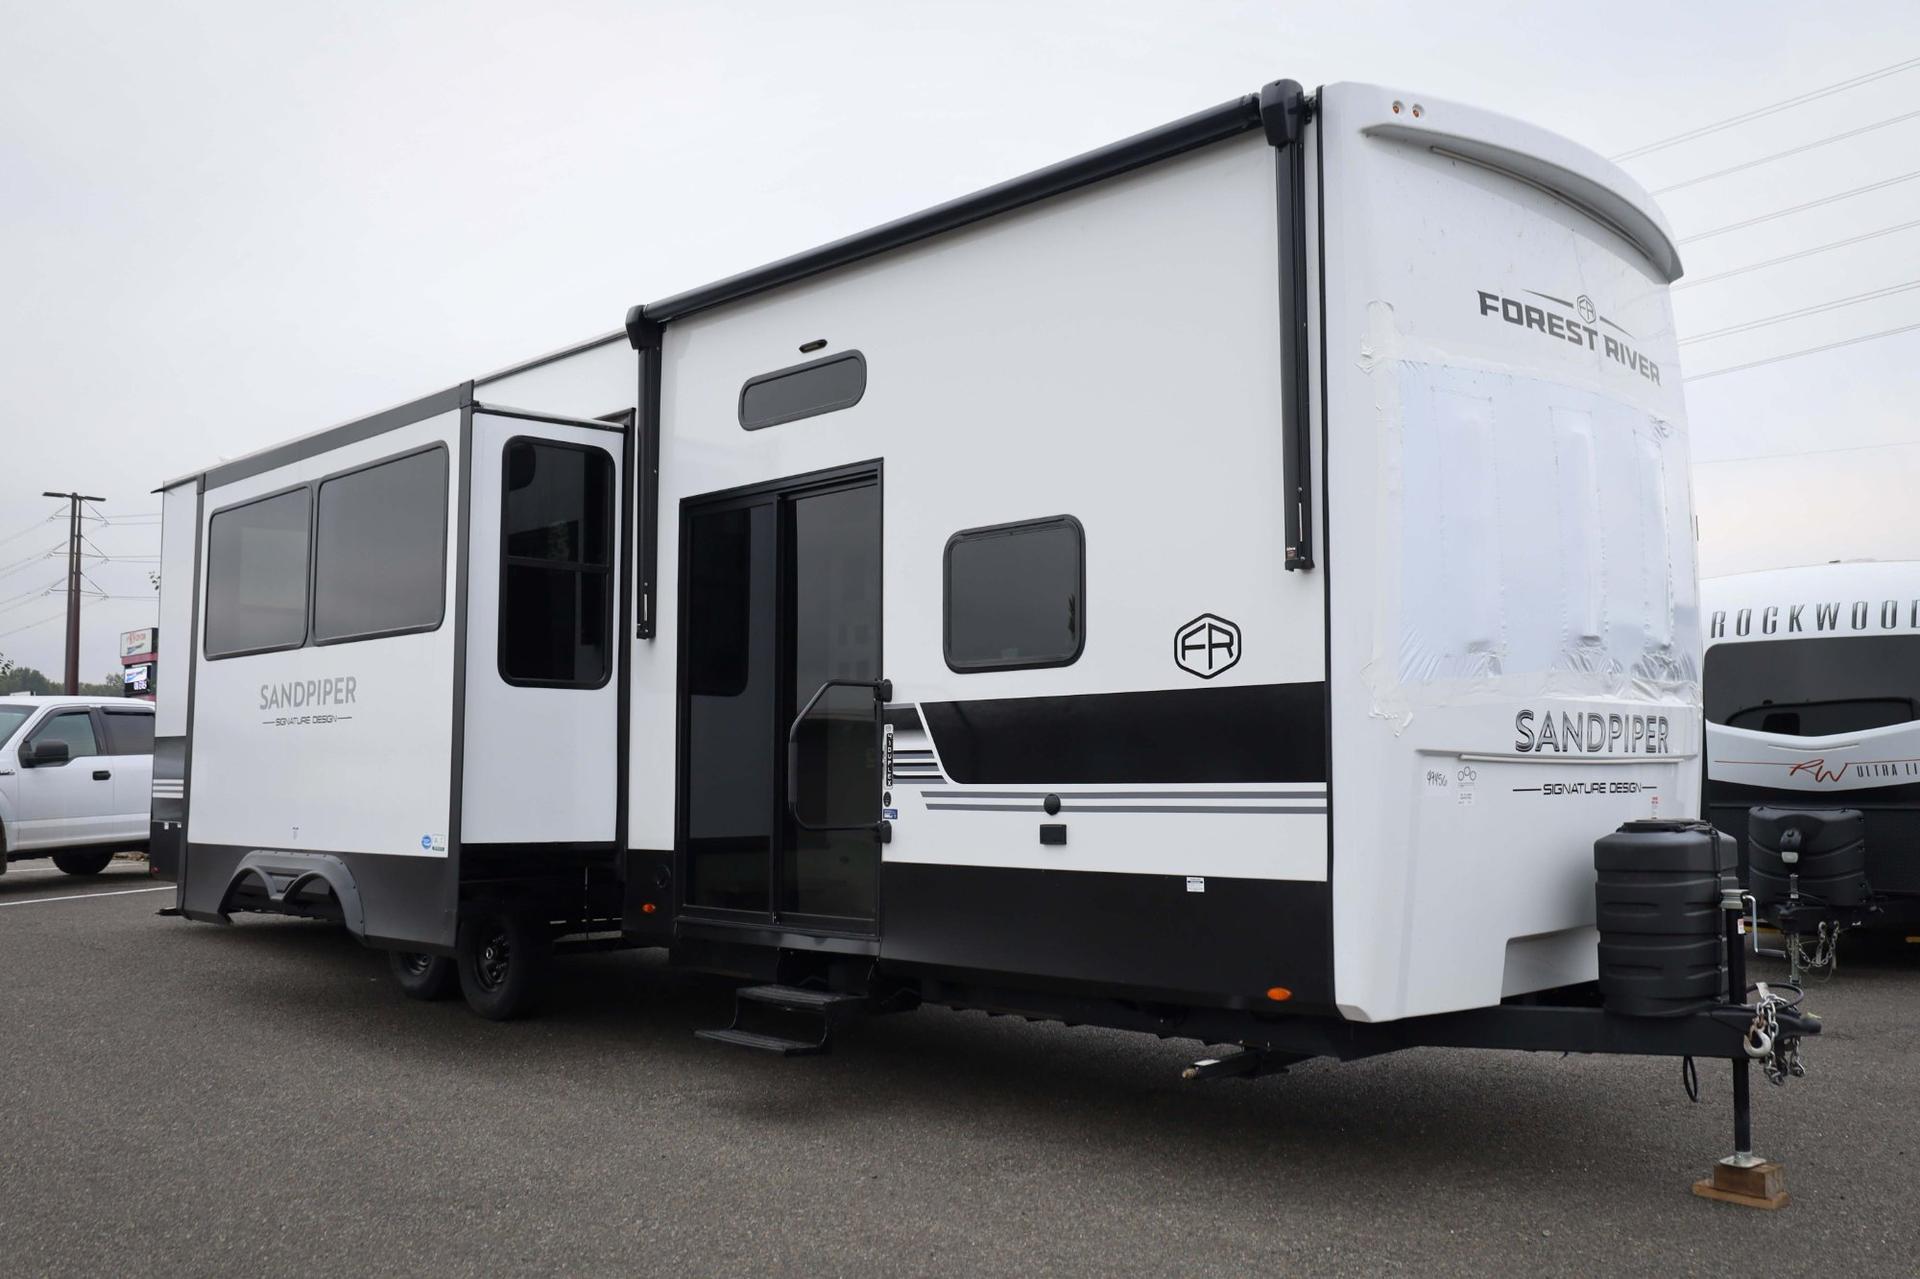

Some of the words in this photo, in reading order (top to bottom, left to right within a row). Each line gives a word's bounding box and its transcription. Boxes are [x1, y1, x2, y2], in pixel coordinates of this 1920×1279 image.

[1477, 290, 1598, 351] FOREST
[1603, 335, 1662, 388] RIVER
[260, 676, 356, 710] SANDPIPER
[275, 716, 311, 726] SIGNATURE
[312, 715, 337, 724] DESIGN
[1515, 709, 1669, 753] SANDPIPER
[1856, 763, 1898, 778] ULTRA
[1543, 783, 1606, 795] SIGNATURE
[1609, 782, 1641, 793] DESIGN
